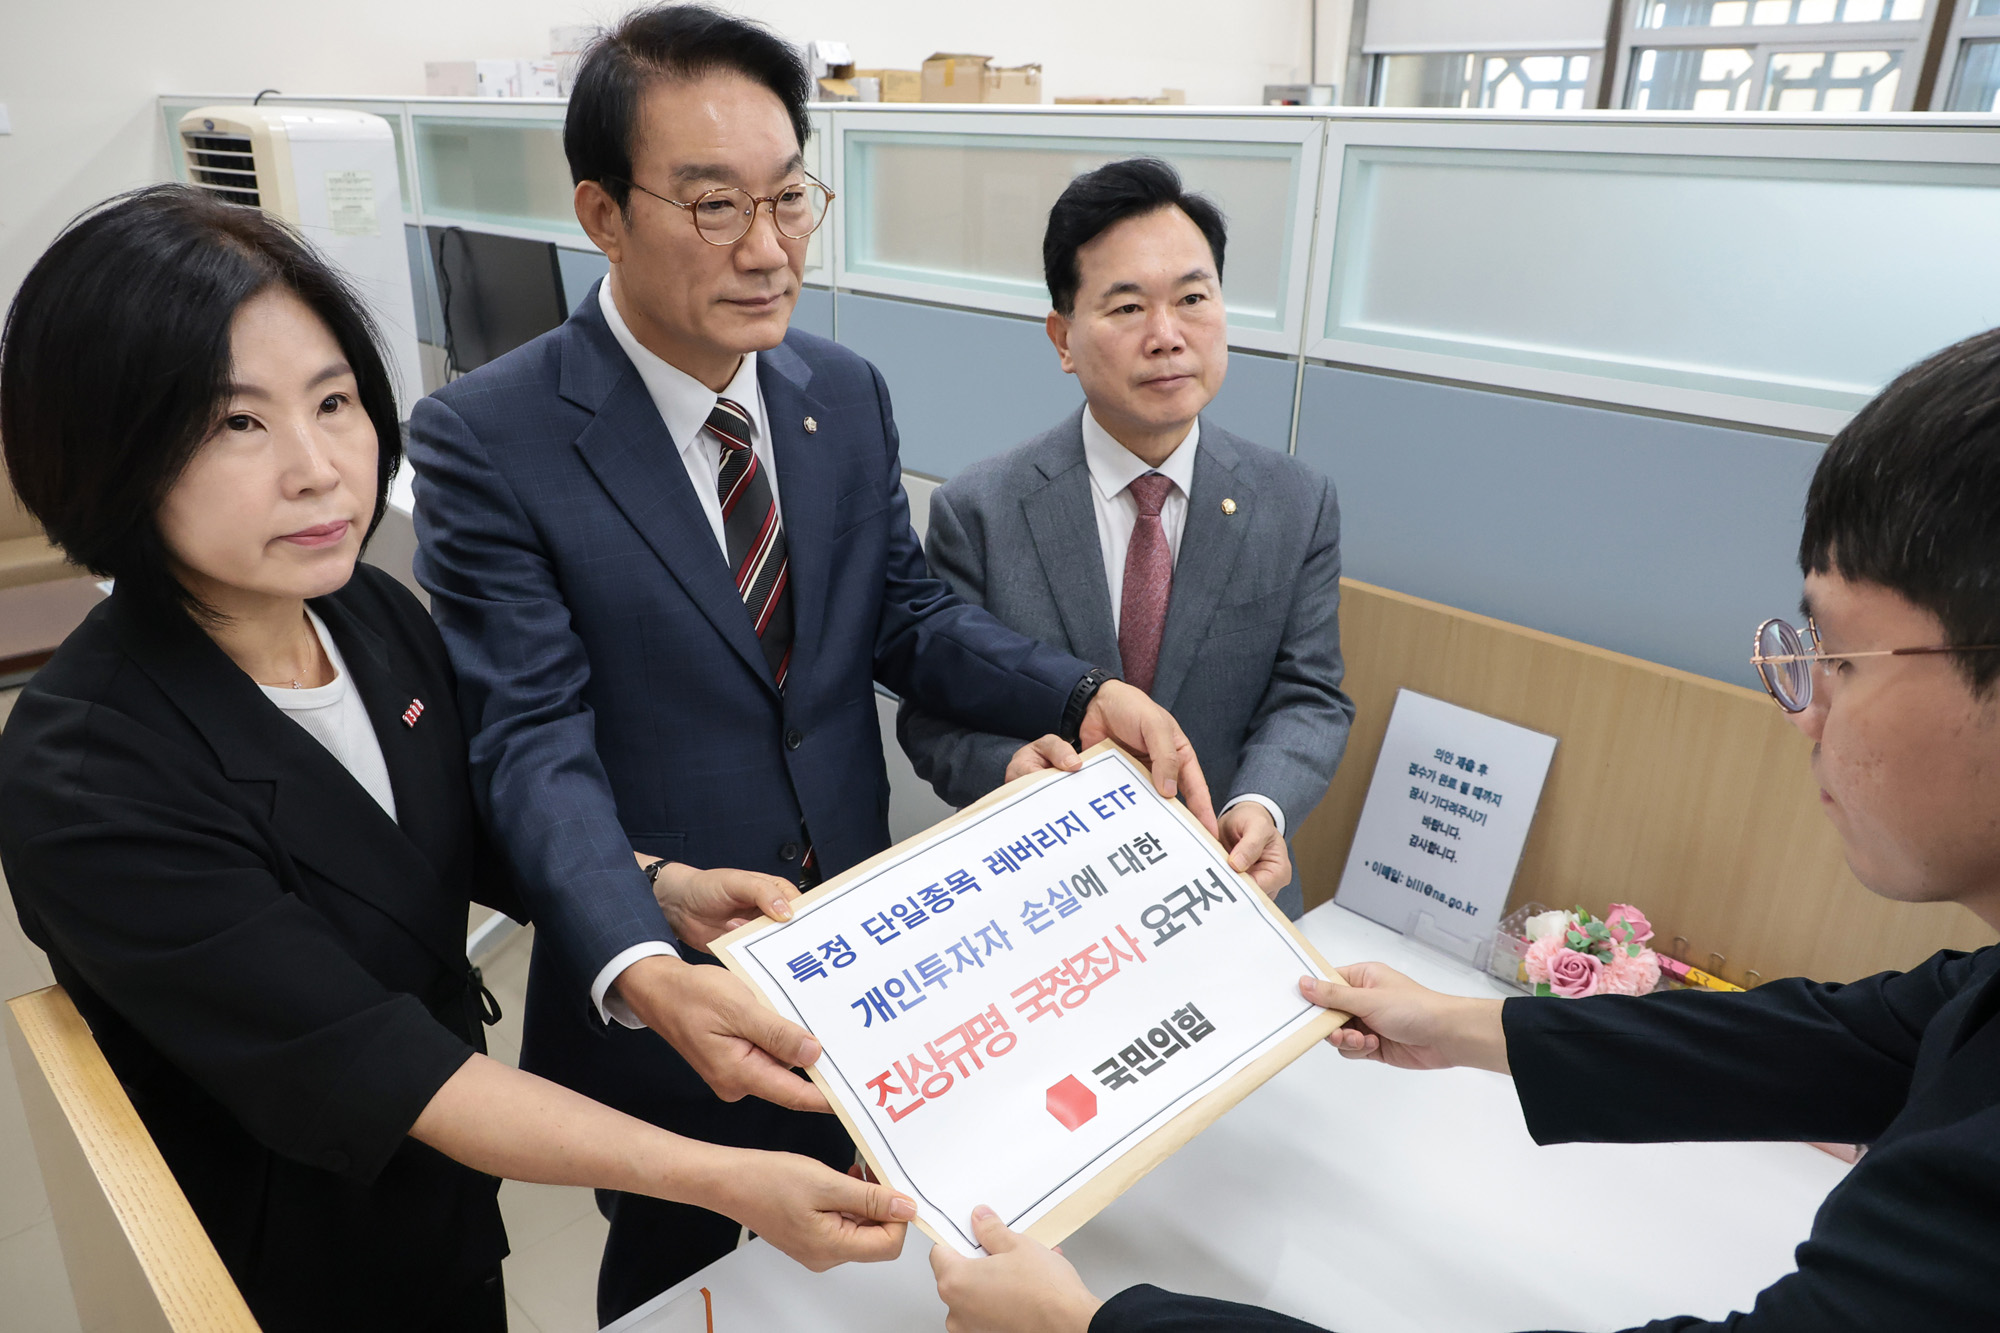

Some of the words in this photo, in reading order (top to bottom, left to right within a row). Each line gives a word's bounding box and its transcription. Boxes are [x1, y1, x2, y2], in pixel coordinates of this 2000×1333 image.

[1434, 748, 1454, 765] 의안
[1409, 762, 1437, 782] 접수가
[1472, 786, 1502, 807] 때까지
[1409, 786, 1428, 804] 잠시
[1430, 795, 1487, 826] 기다려주시기
[1409, 834, 1457, 863] 감사합니다.
[1422, 815, 1461, 840] 바랍니다.
[786, 934, 856, 982] 특정
[861, 869, 982, 945] 단일종목
[982, 810, 1090, 875] 레버리지
[1089, 784, 1139, 820] ETF
[1406, 876, 1478, 916] bill@na.go.kr
[851, 920, 1013, 1028] 개인투자자
[1020, 866, 1108, 934] 손실에
[1108, 832, 1167, 876] 대한
[866, 1004, 1017, 1123] 진상규명
[1011, 925, 1146, 1022] 국정조사
[1141, 867, 1238, 947] 요구서
[1092, 1002, 1216, 1090] 국민의힘
